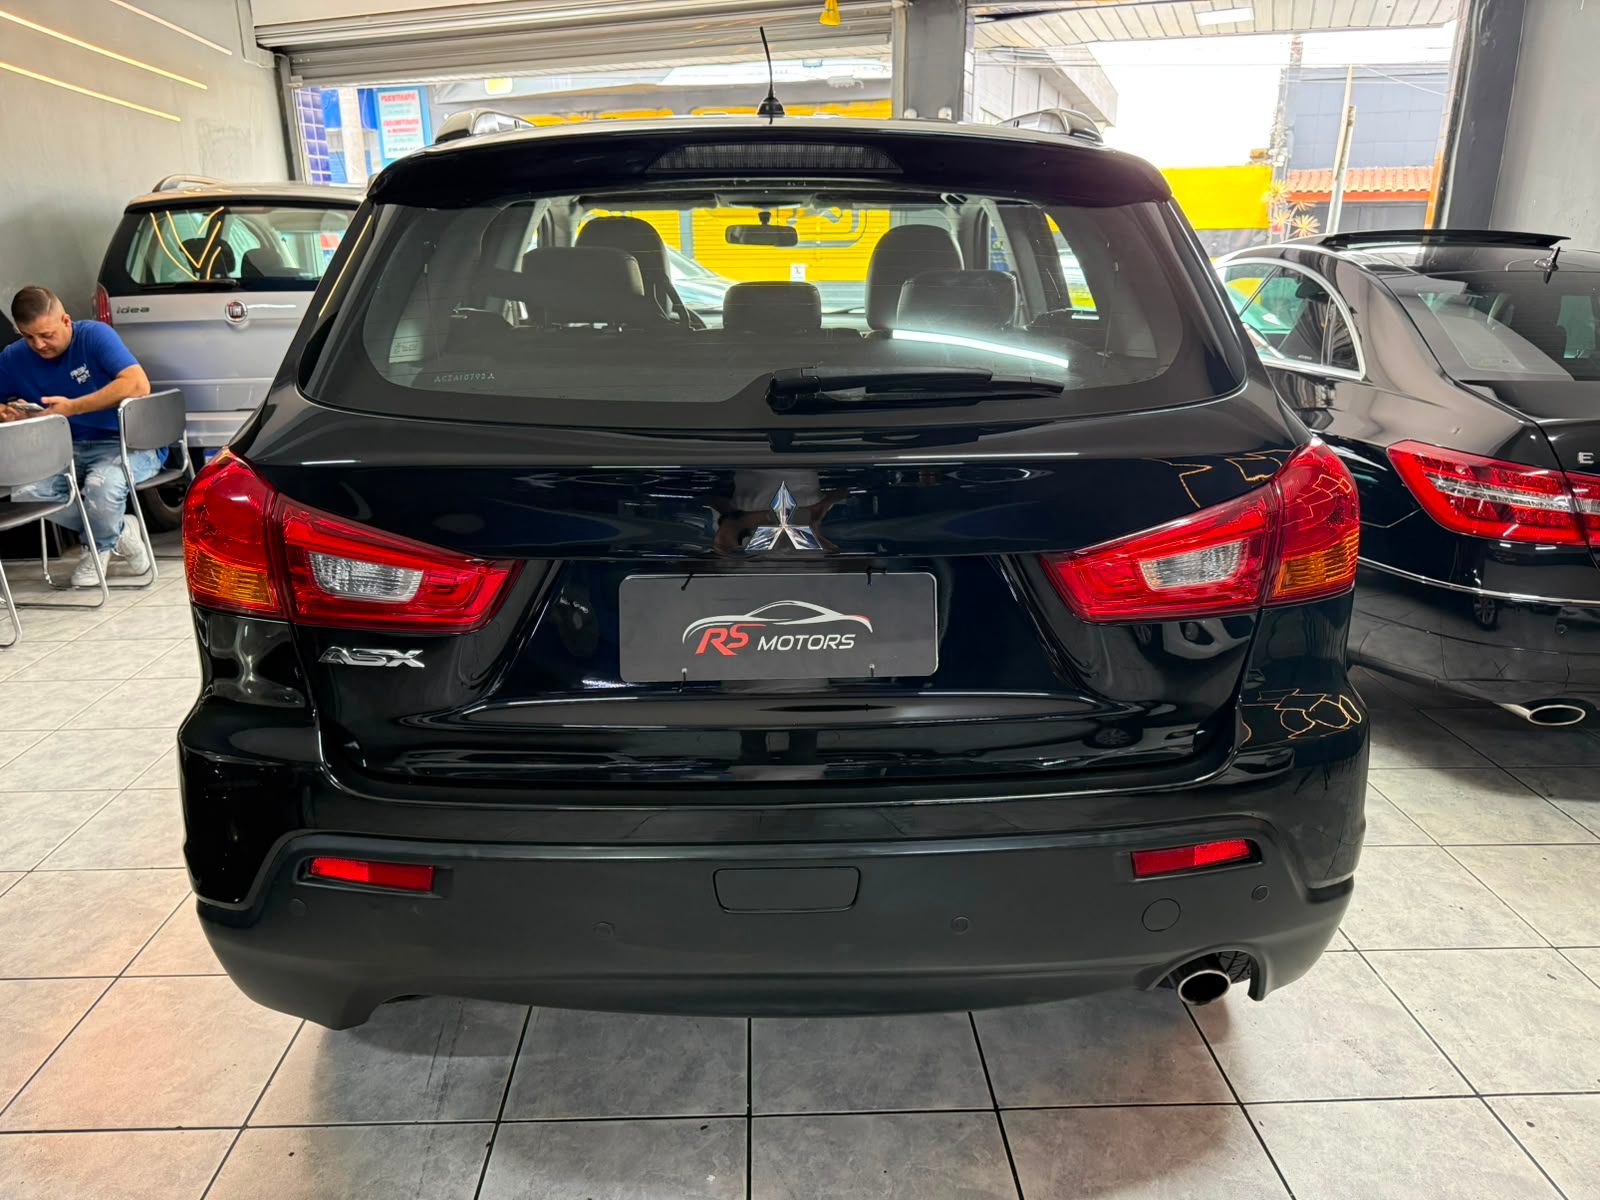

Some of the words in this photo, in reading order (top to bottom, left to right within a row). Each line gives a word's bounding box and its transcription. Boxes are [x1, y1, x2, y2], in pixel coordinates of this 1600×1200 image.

[1578, 451, 1594, 464] E
[695, 623, 767, 656] RS
[757, 633, 856, 651] MOTORS
[318, 646, 425, 668] ASX
